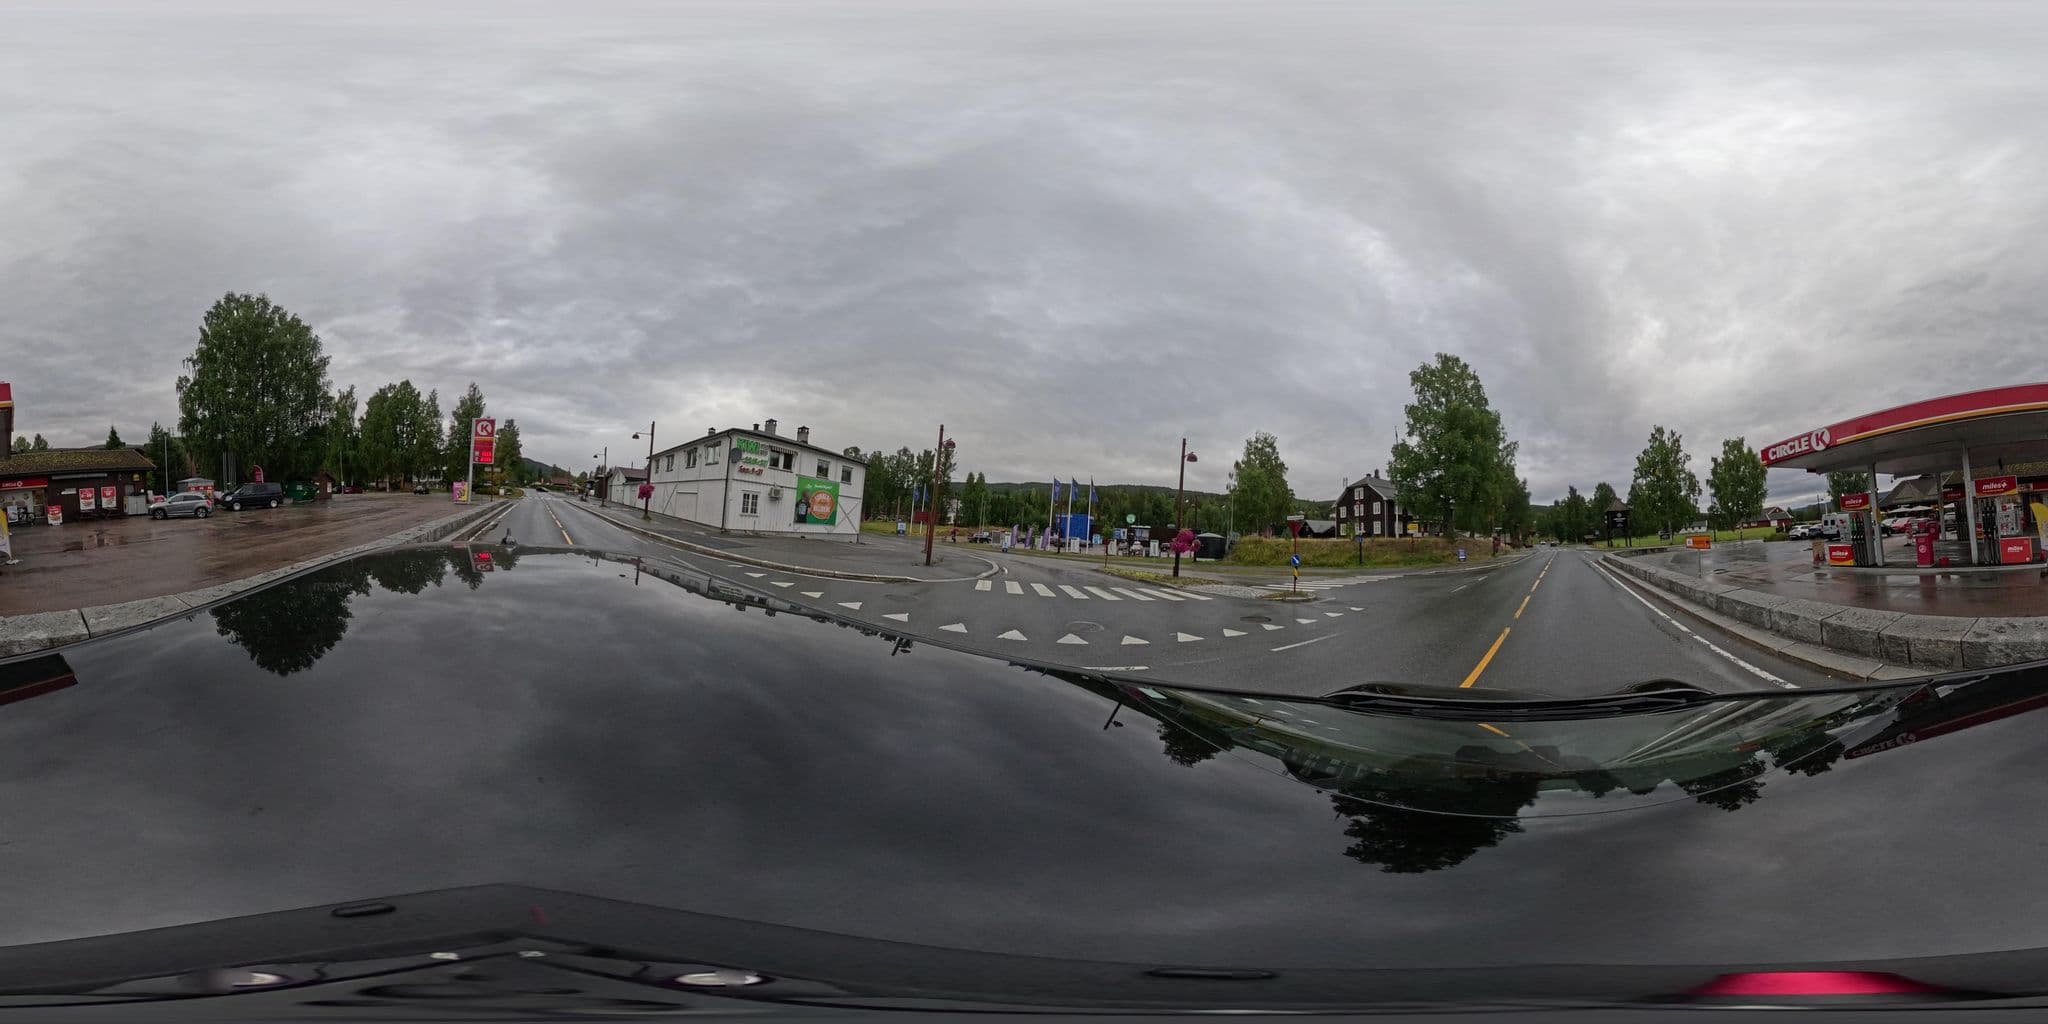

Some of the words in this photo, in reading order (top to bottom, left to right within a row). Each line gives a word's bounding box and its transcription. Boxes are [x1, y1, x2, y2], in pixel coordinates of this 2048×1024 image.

[479, 422, 493, 436] K
[1768, 437, 1810, 460] CIRCLE
[1813, 429, 1830, 450] K
